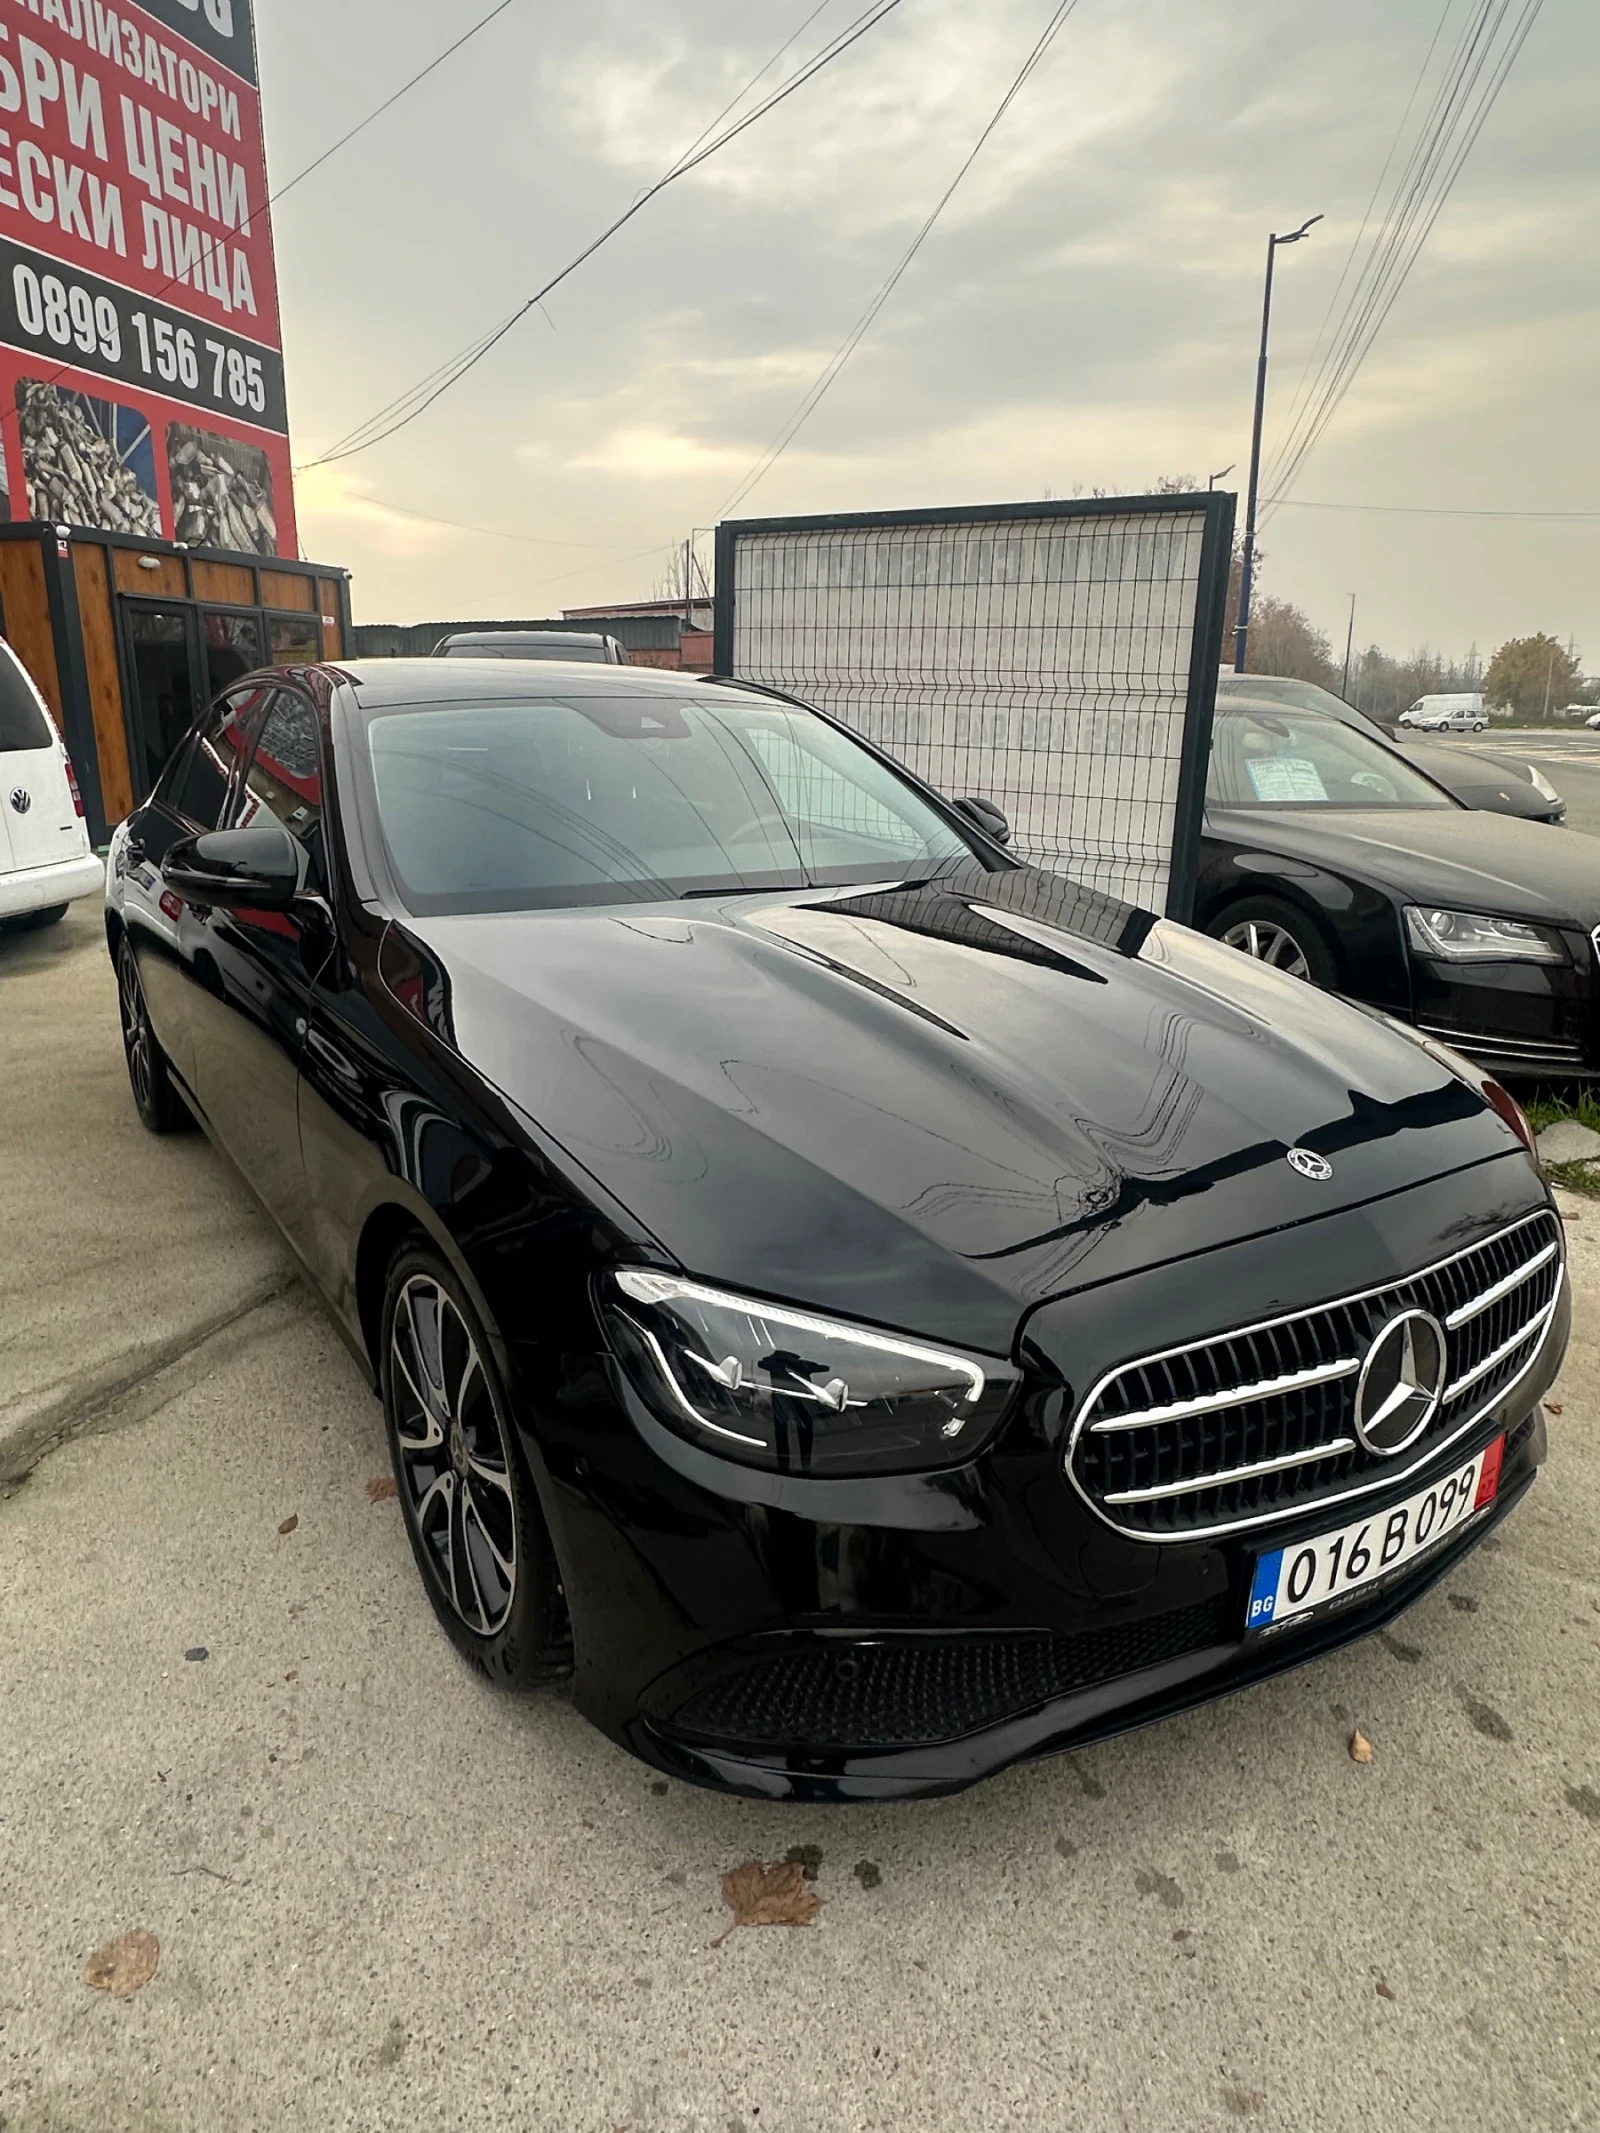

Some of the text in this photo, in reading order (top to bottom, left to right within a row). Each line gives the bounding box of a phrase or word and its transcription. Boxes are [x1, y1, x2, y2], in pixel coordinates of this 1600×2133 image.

[15, 0, 242, 141] АЛИЗАТОРИ
[119, 93, 251, 238] ЦЕНИ
[142, 200, 258, 317] ЛИЦА
[13, 264, 266, 413] 0899 156 785
[1251, 1595, 1273, 1617] BG
